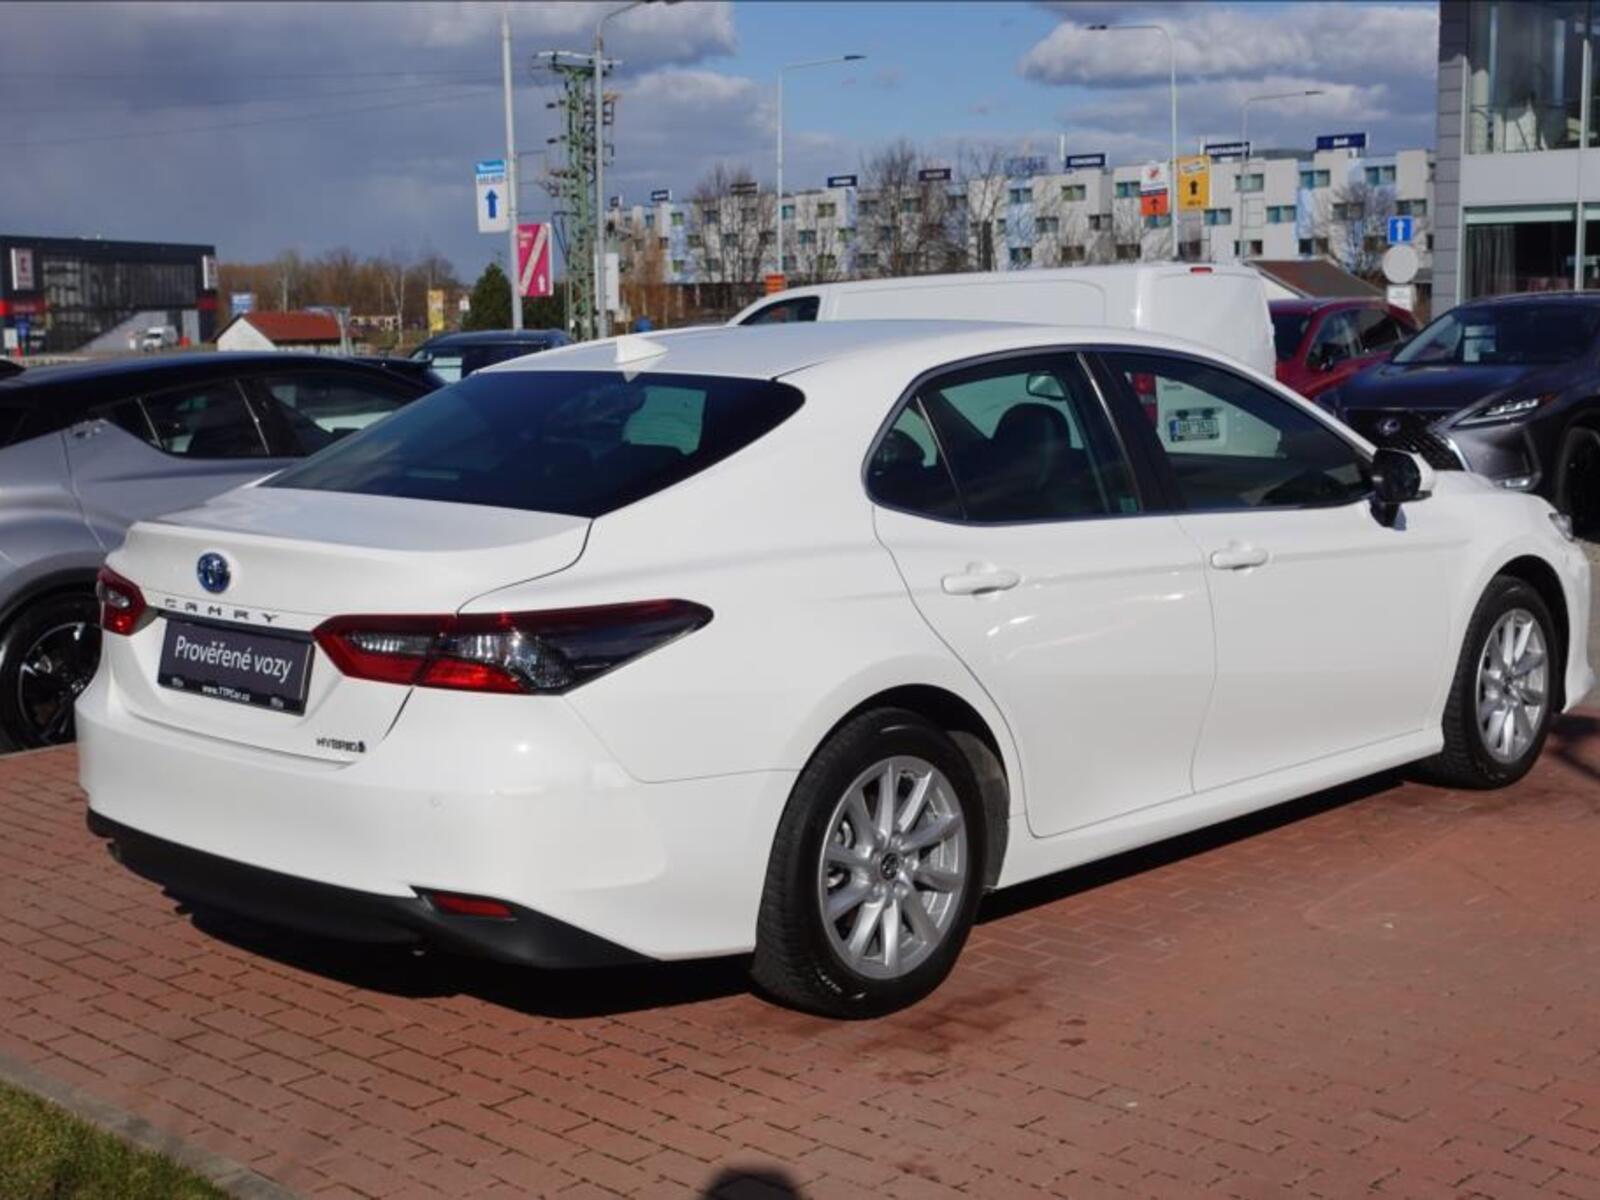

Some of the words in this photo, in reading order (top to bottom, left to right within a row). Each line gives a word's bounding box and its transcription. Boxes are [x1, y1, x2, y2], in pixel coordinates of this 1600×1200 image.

[165, 598, 278, 622] CAMRY
[175, 635, 251, 671] Prověřené
[254, 654, 292, 684] vozy
[316, 737, 357, 752] HYBRID
